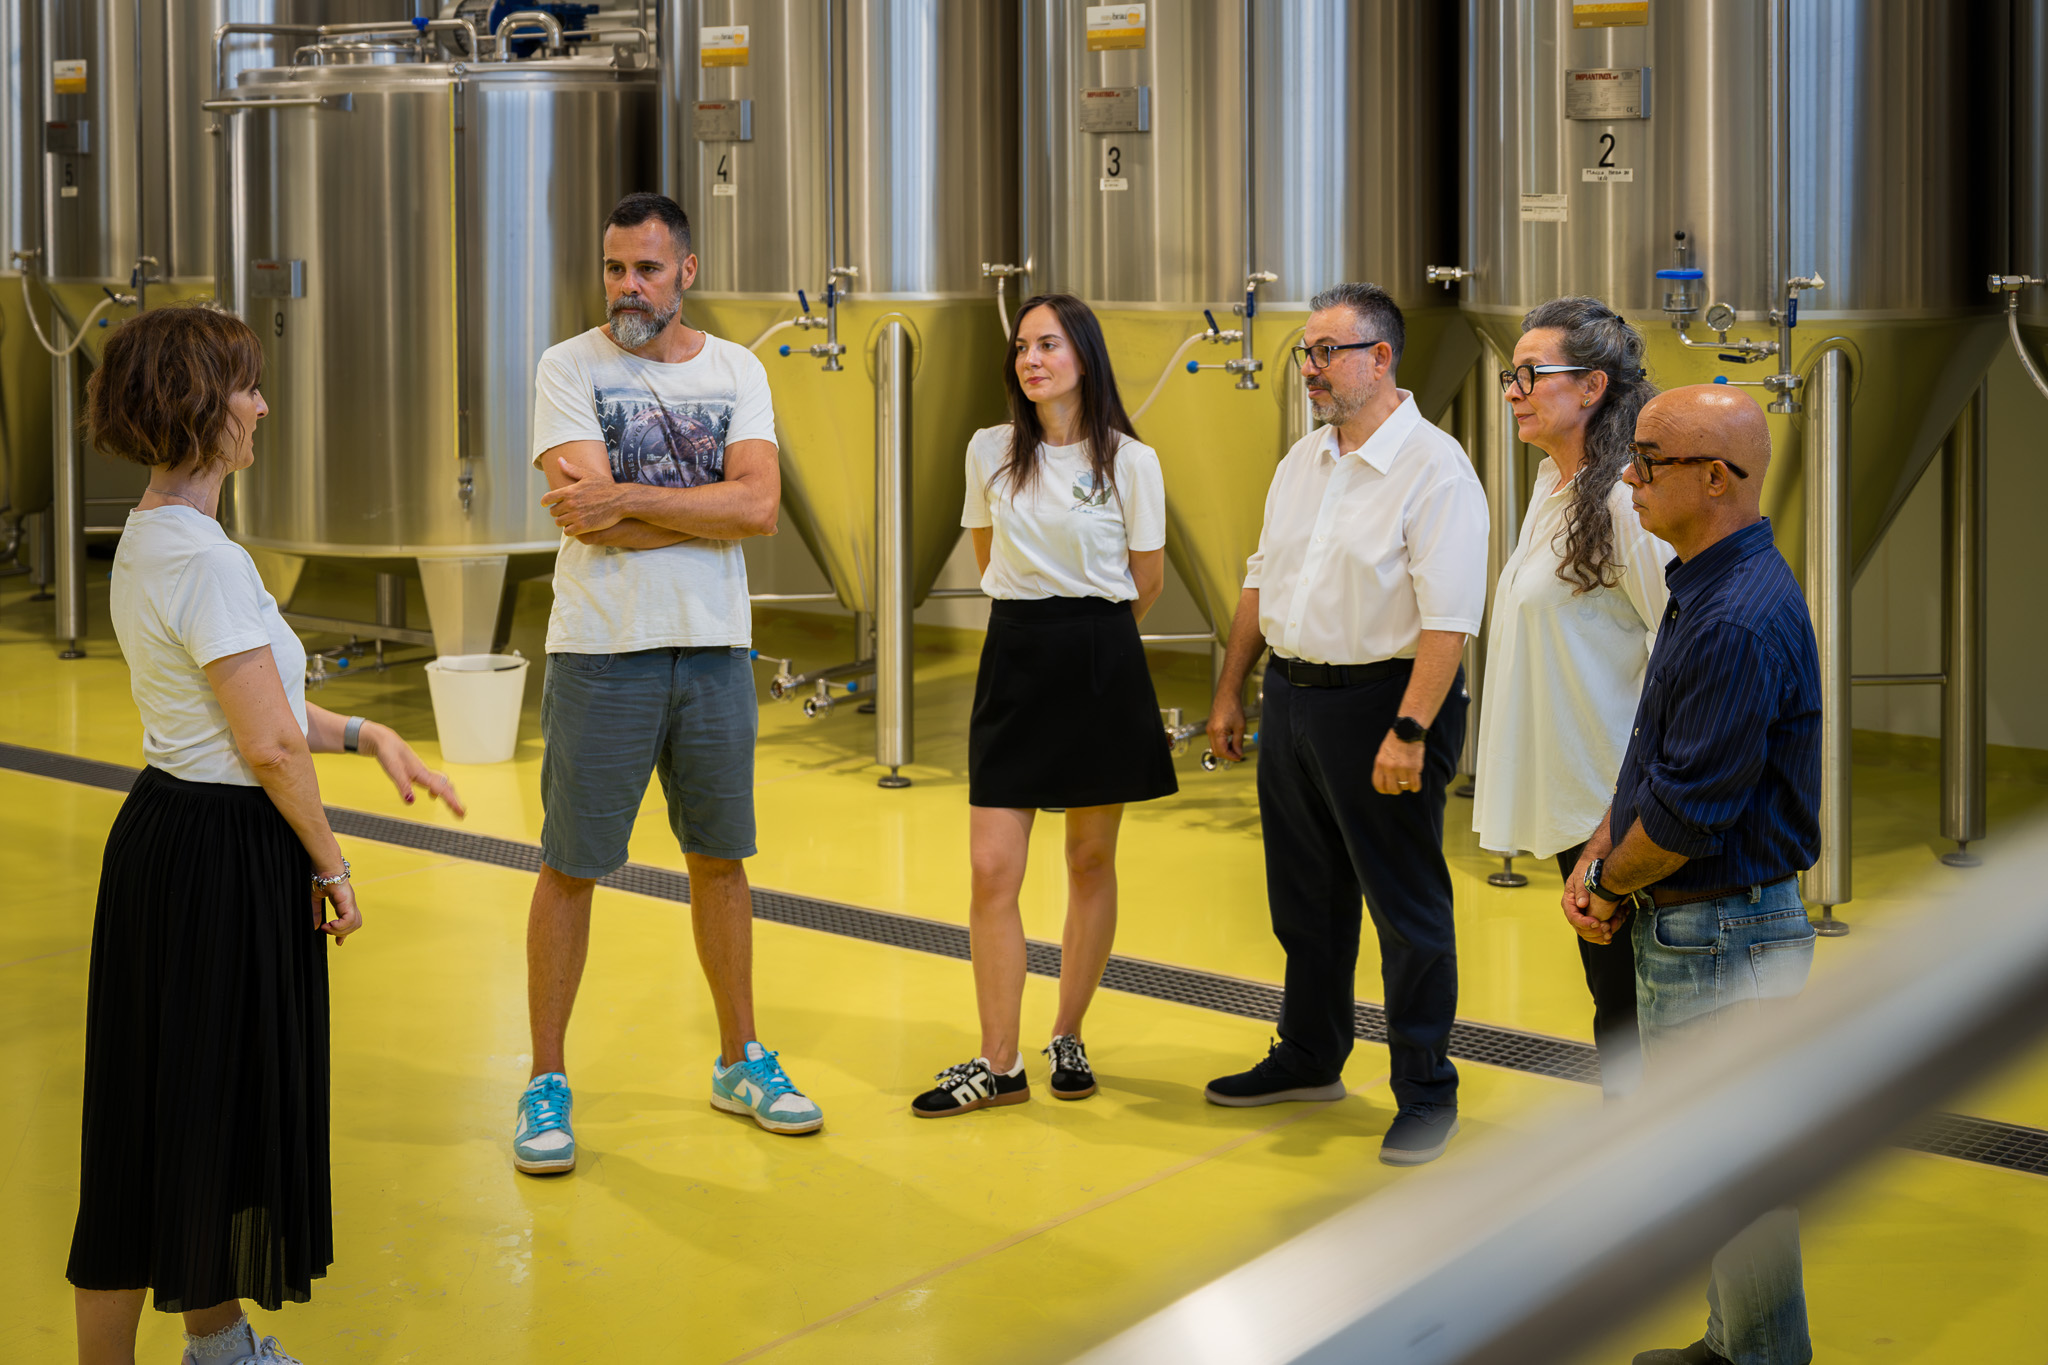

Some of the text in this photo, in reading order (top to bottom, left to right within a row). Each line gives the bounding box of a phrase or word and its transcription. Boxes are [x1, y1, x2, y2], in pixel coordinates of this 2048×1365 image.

[1107, 146, 1121, 177] 3
[1599, 133, 1615, 168] 2
[65, 163, 74, 187] 5
[717, 154, 728, 183] 4
[275, 311, 285, 338] 9
